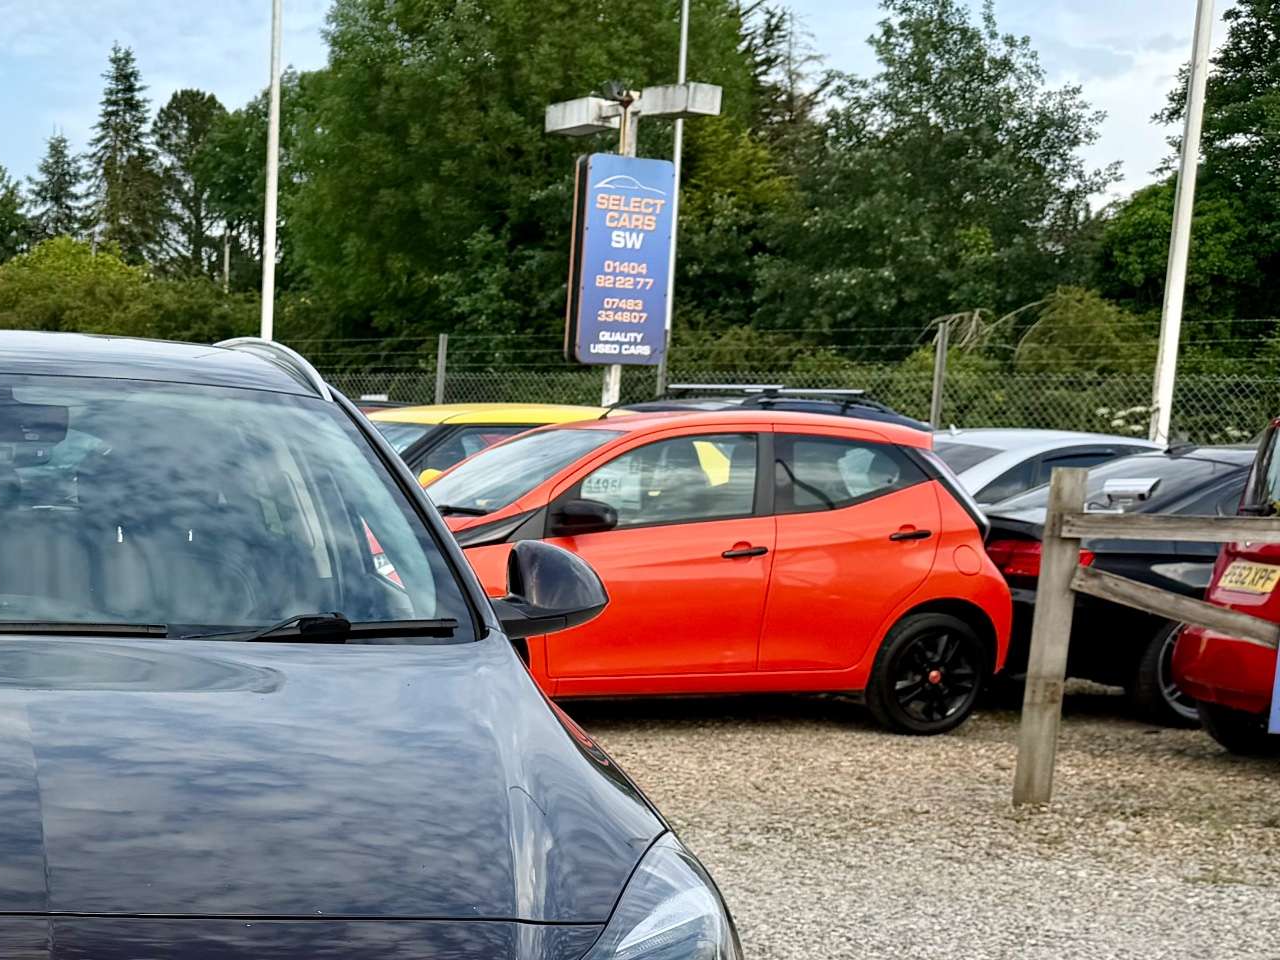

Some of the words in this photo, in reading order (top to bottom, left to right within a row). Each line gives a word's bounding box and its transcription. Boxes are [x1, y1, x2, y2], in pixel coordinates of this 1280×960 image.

[595, 193, 665, 215] SELECT
[606, 211, 657, 232] CARS
[611, 230, 644, 250] SW
[604, 260, 648, 275] 01404
[603, 297, 644, 311] 07483
[599, 330, 644, 343] QUALITY
[590, 343, 619, 354] USED
[621, 344, 651, 356] CARS
